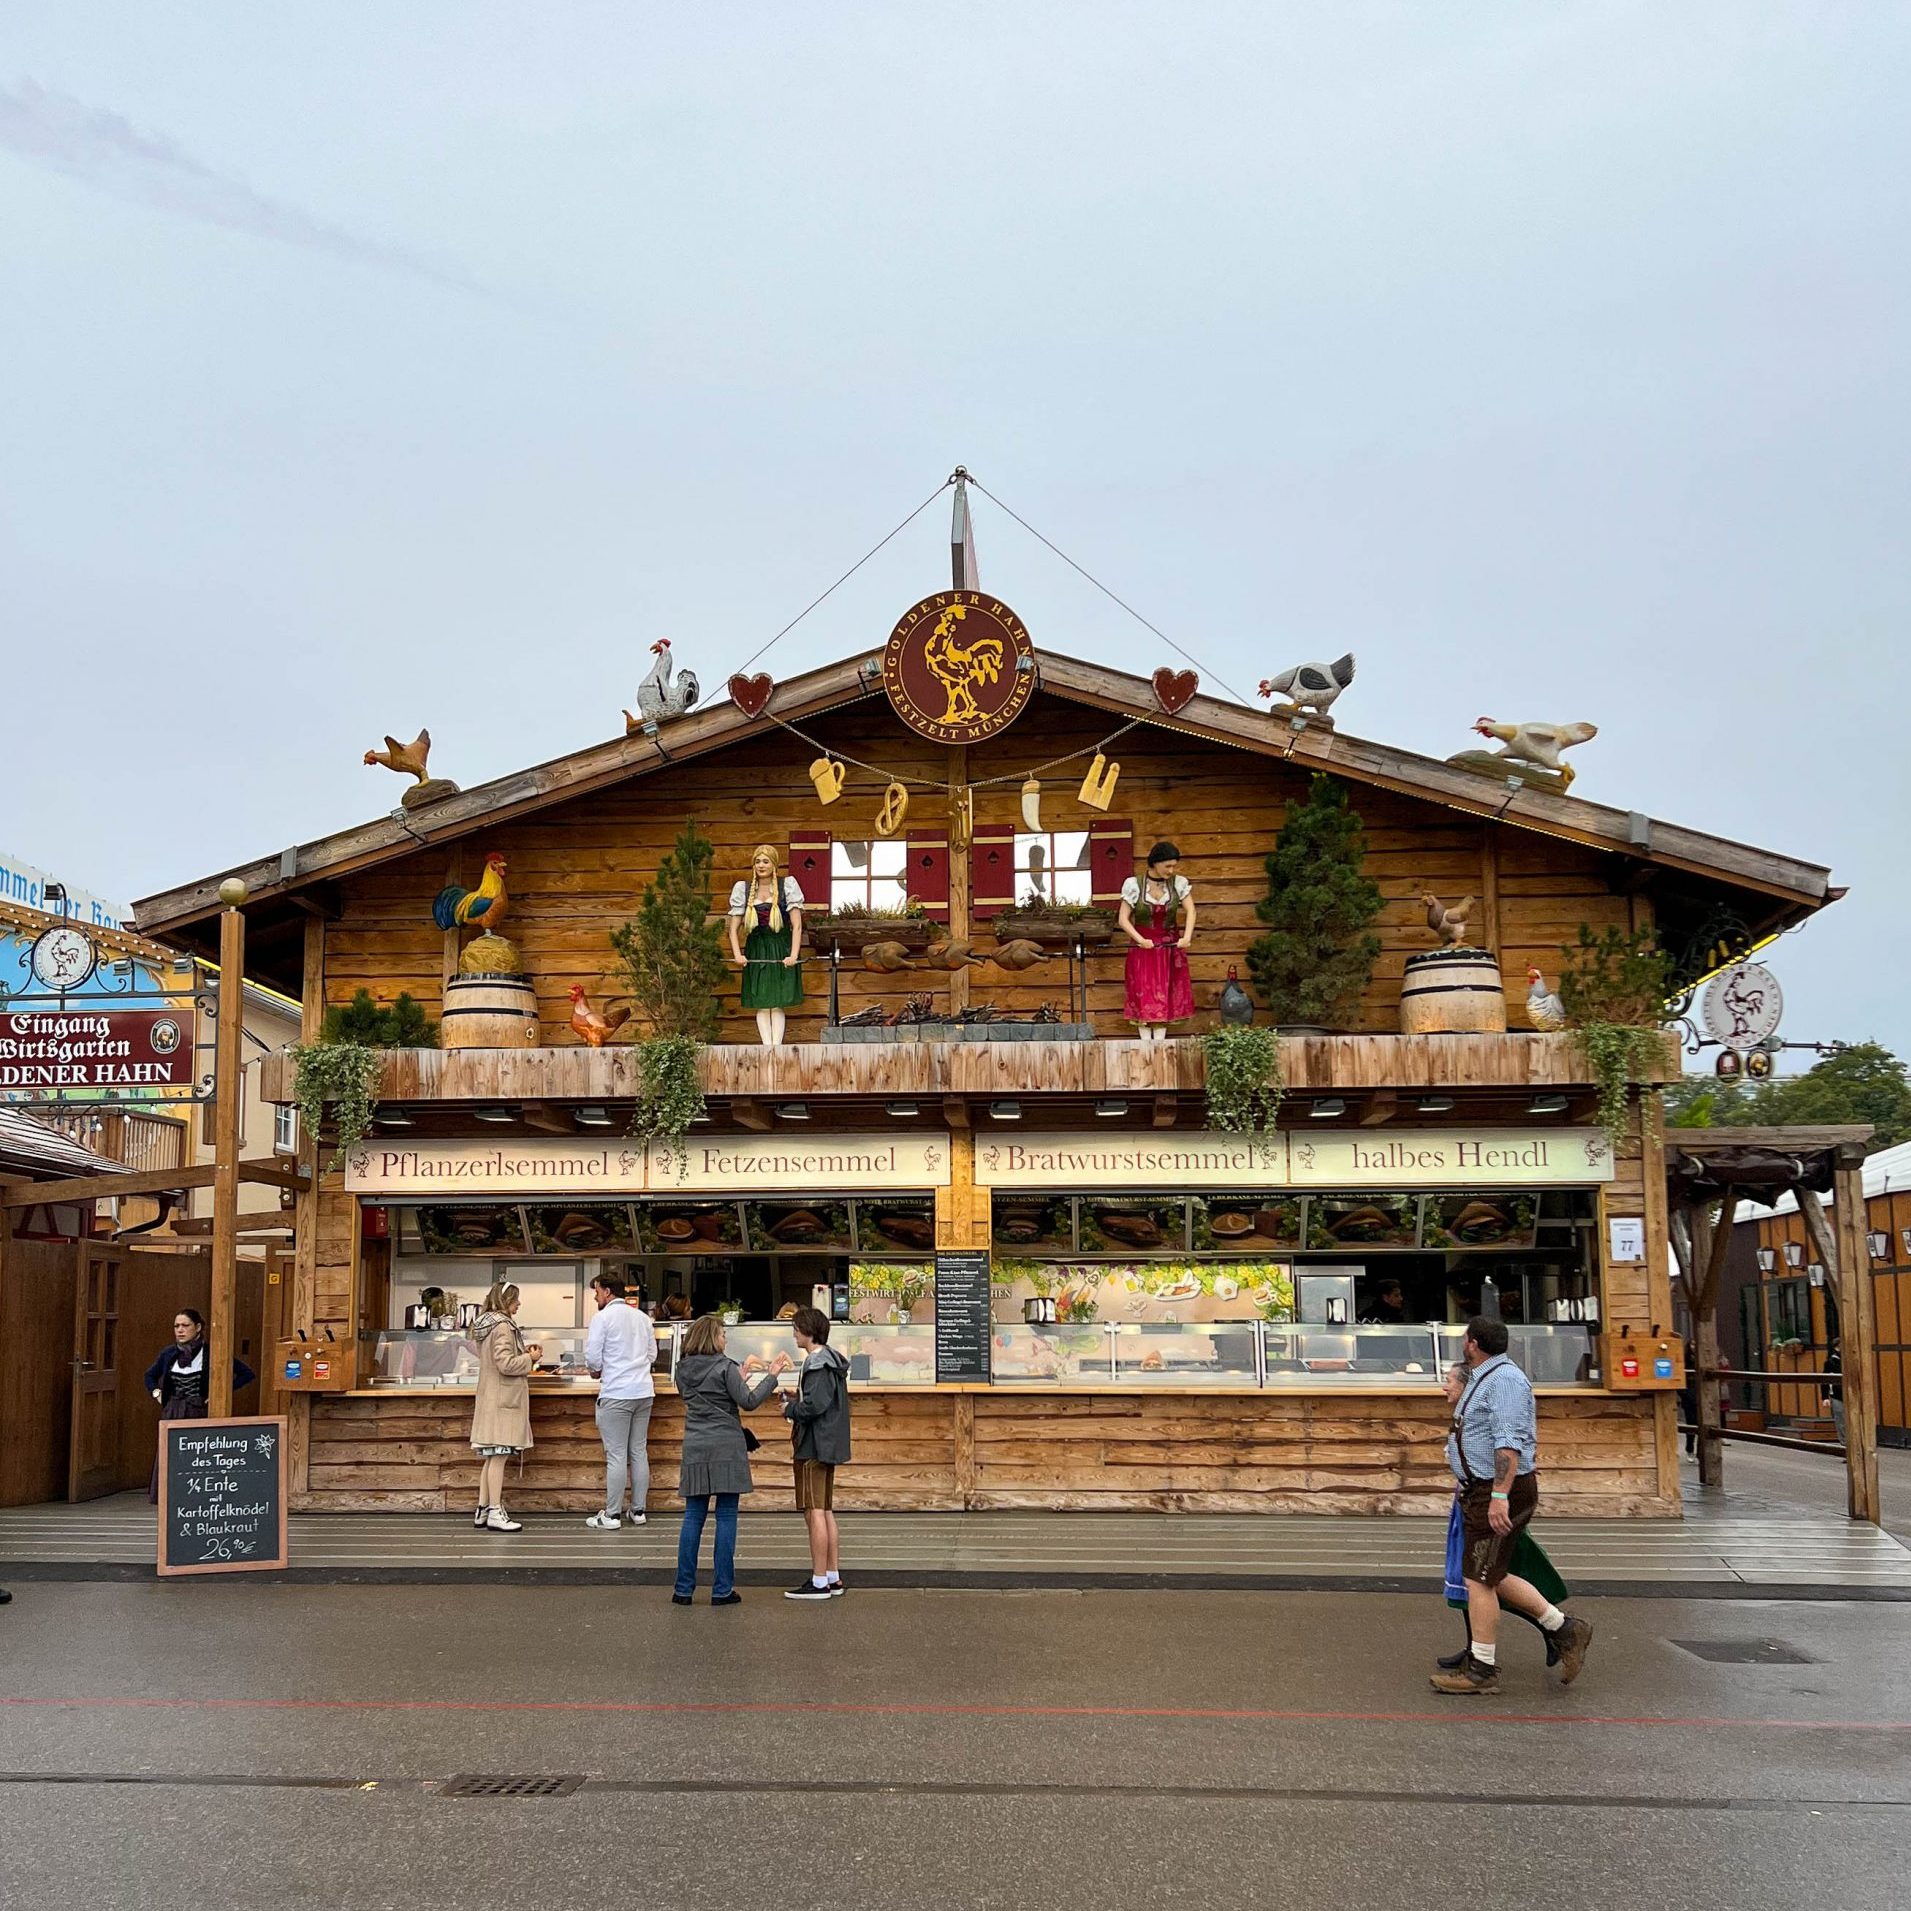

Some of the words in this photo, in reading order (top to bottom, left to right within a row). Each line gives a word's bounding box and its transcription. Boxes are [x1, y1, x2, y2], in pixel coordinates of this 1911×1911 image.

[888, 593, 979, 667] GOLDENER
[991, 603, 1031, 656] HAHN
[890, 684, 959, 738] FESTZELT
[968, 673, 1030, 738] MÜNCHEN
[10, 1014, 110, 1039] Eingang
[0, 1065, 88, 1085] DENER
[95, 1063, 173, 1083] HAHN
[380, 1151, 608, 1177] Pflanzerlsemmel
[701, 1147, 896, 1174] Fetzensemmel
[1006, 1144, 1254, 1171] Bratwurstsemmel
[1352, 1143, 1445, 1169] halbes
[1456, 1141, 1549, 1167] Hendl
[179, 1436, 248, 1454] Empfehlung
[191, 1457, 212, 1467] des
[213, 1454, 246, 1469] Tages
[204, 1476, 239, 1492] Ente
[209, 1493, 222, 1502] mit
[177, 1501, 269, 1520] Kartoffelknödel
[180, 1522, 192, 1537] &
[196, 1518, 260, 1536] Blaukraut
